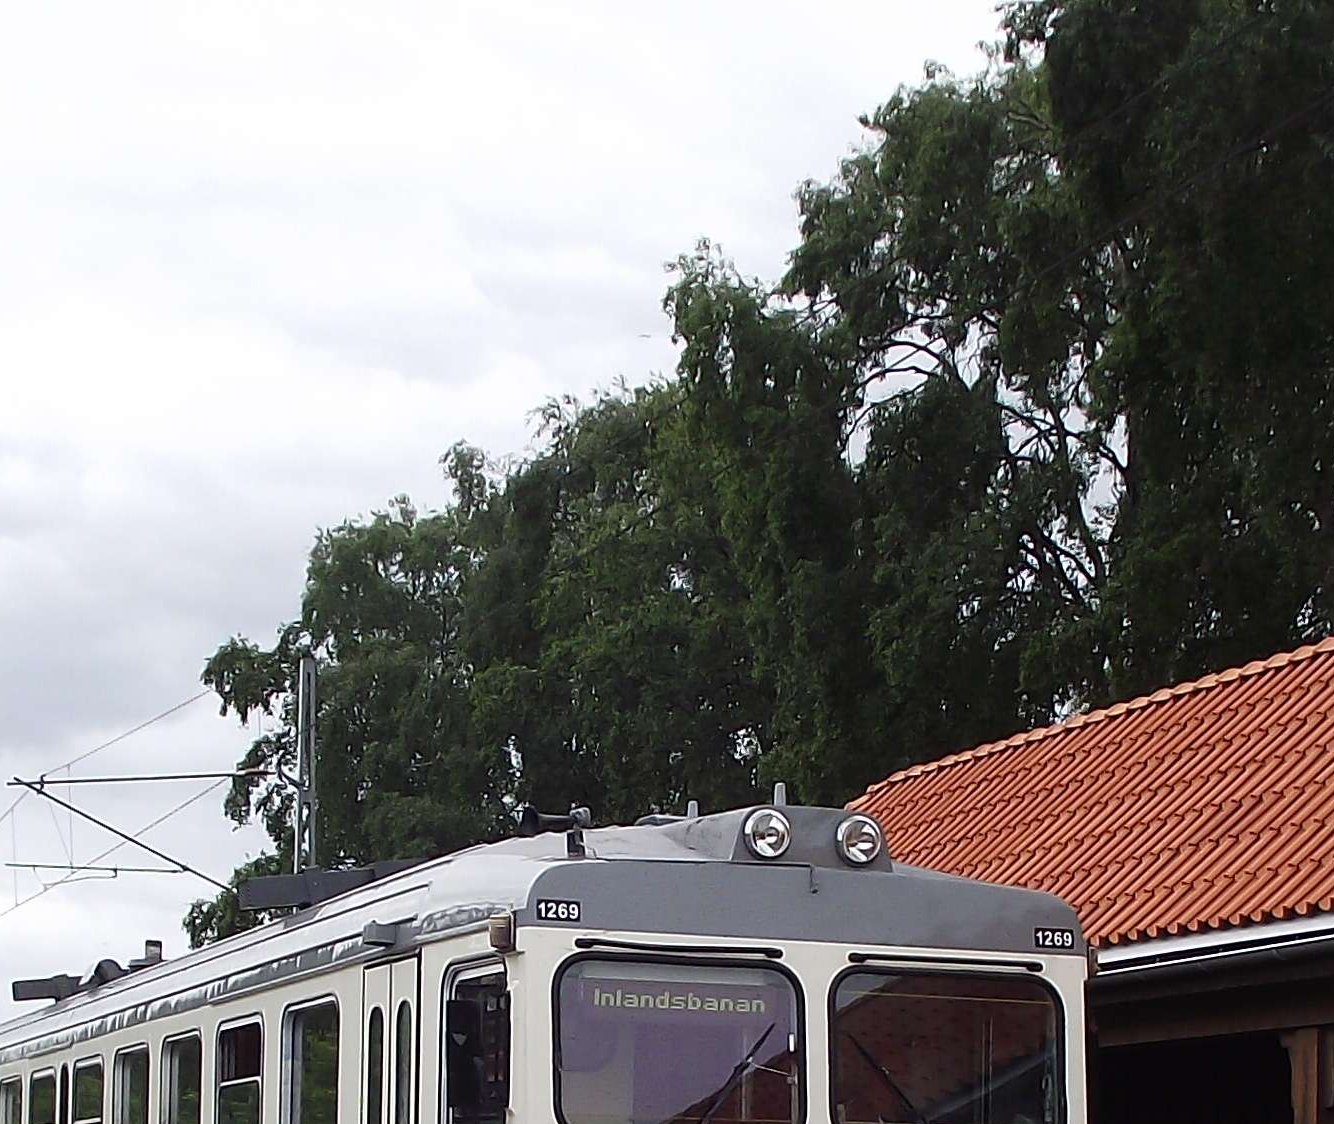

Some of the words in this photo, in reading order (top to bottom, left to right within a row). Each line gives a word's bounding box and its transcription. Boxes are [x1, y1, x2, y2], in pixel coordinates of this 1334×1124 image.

[537, 901, 580, 920] 1269
[1035, 930, 1073, 947] 1269
[593, 987, 766, 1013] Inlandsbanan
